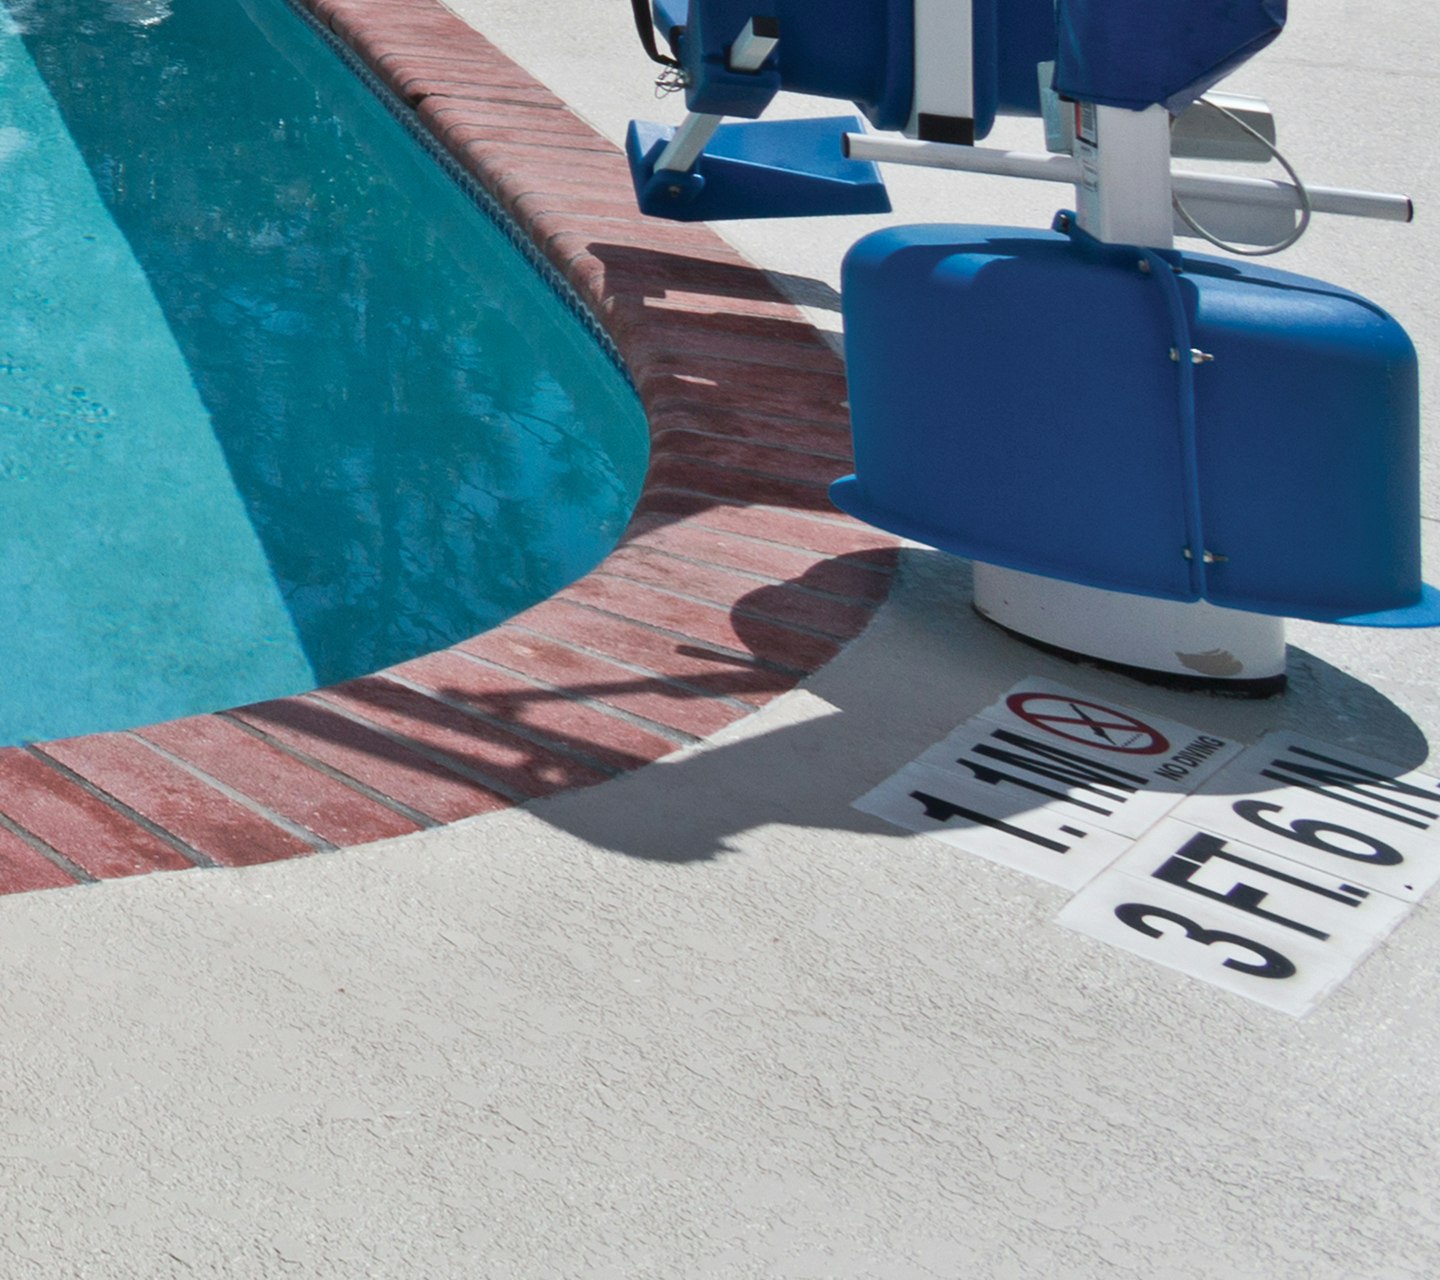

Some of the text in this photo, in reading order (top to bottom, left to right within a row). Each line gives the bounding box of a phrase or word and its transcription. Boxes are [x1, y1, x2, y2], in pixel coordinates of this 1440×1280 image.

[1153, 735, 1227, 781] NO DIVING
[1259, 745, 1440, 830] IN
